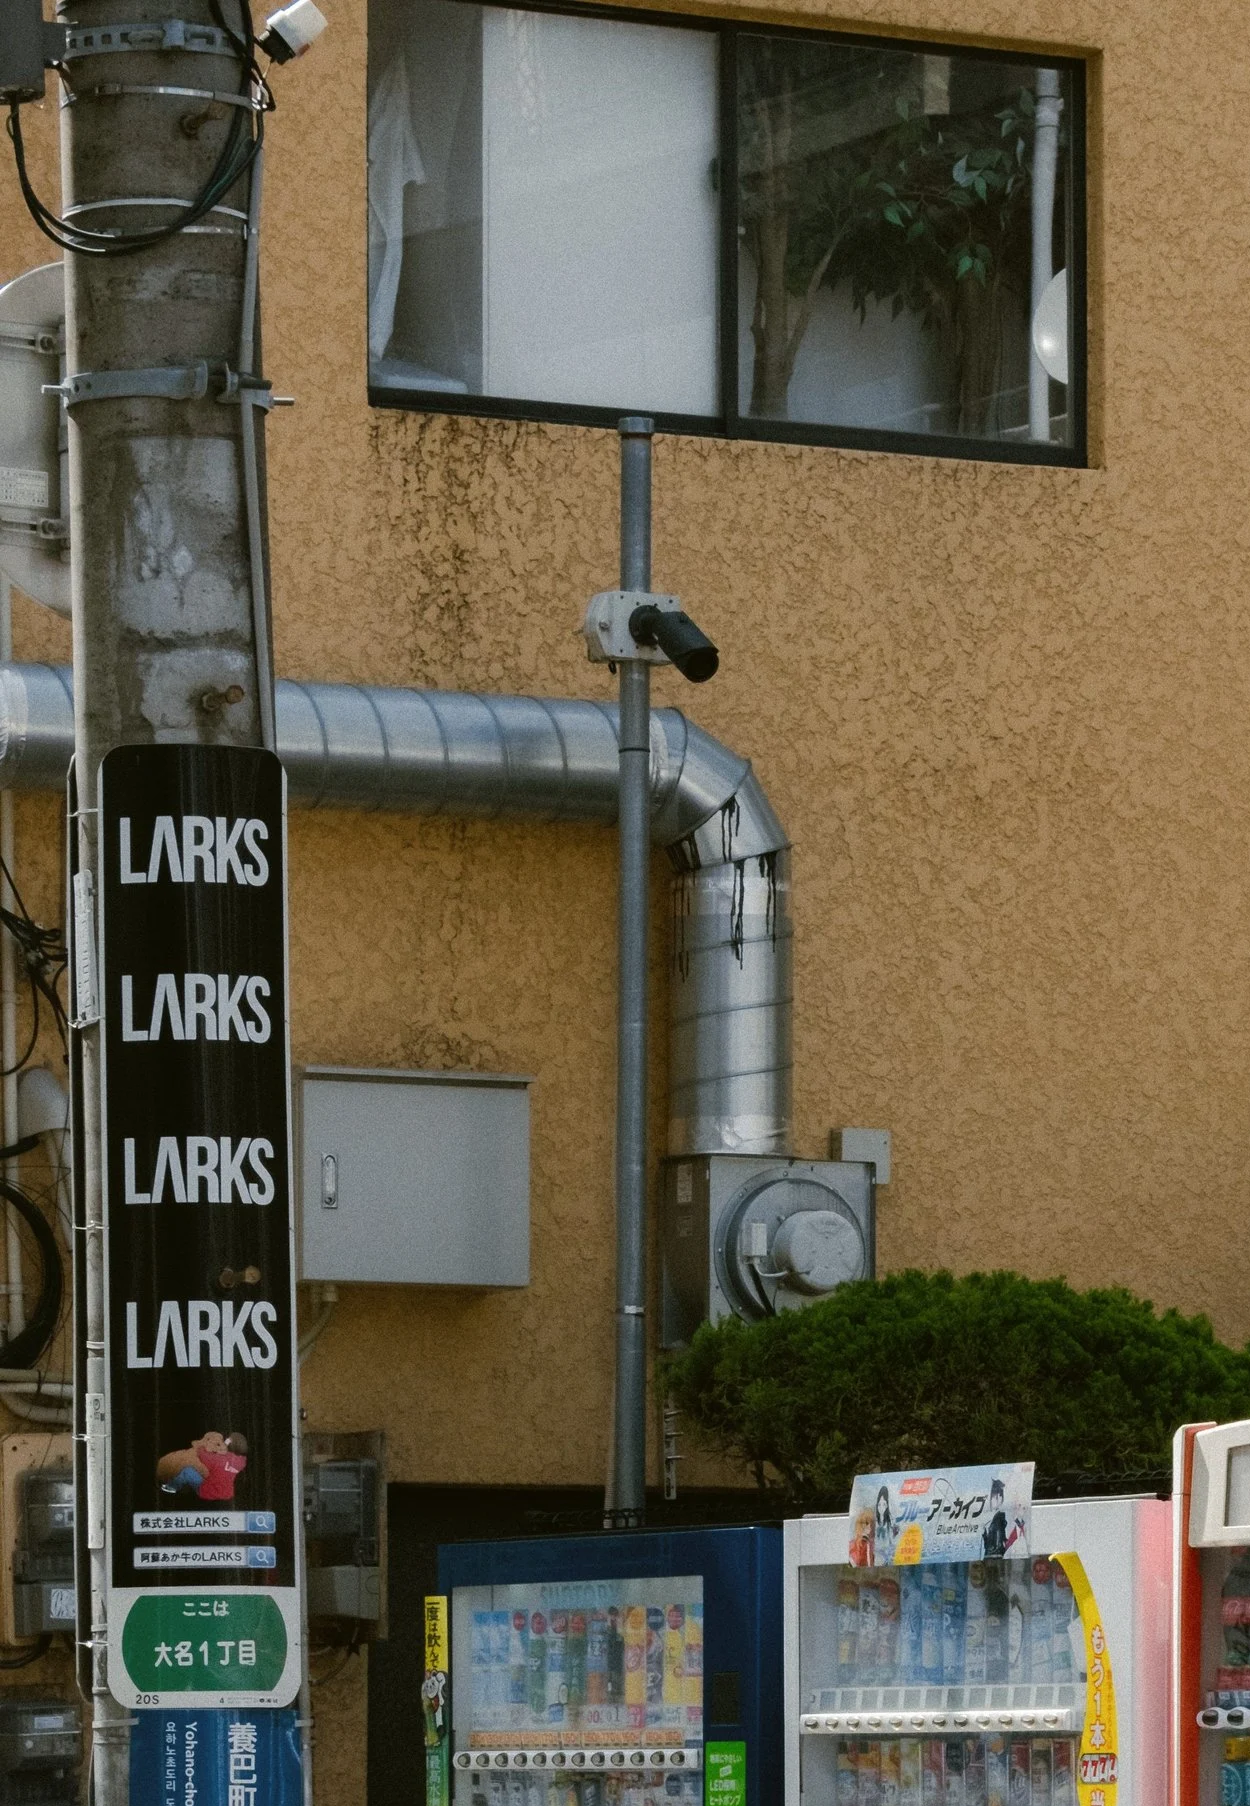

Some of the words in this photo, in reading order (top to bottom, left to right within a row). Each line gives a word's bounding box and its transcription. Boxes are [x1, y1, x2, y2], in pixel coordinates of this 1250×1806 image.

[120, 815, 269, 886] LARKS
[122, 974, 271, 1043] LARKS
[125, 1136, 274, 1205] LARKS
[127, 1300, 278, 1369] LARKS
[140, 1516, 230, 1529] 株式会社LARKS
[182, 1601, 230, 1617] ここは
[154, 1640, 257, 1667] 大名1丁目
[1089, 1624, 1106, 1751] もう1本
[135, 1694, 160, 1705] 20S
[165, 1721, 177, 1792] 요하노초도리
